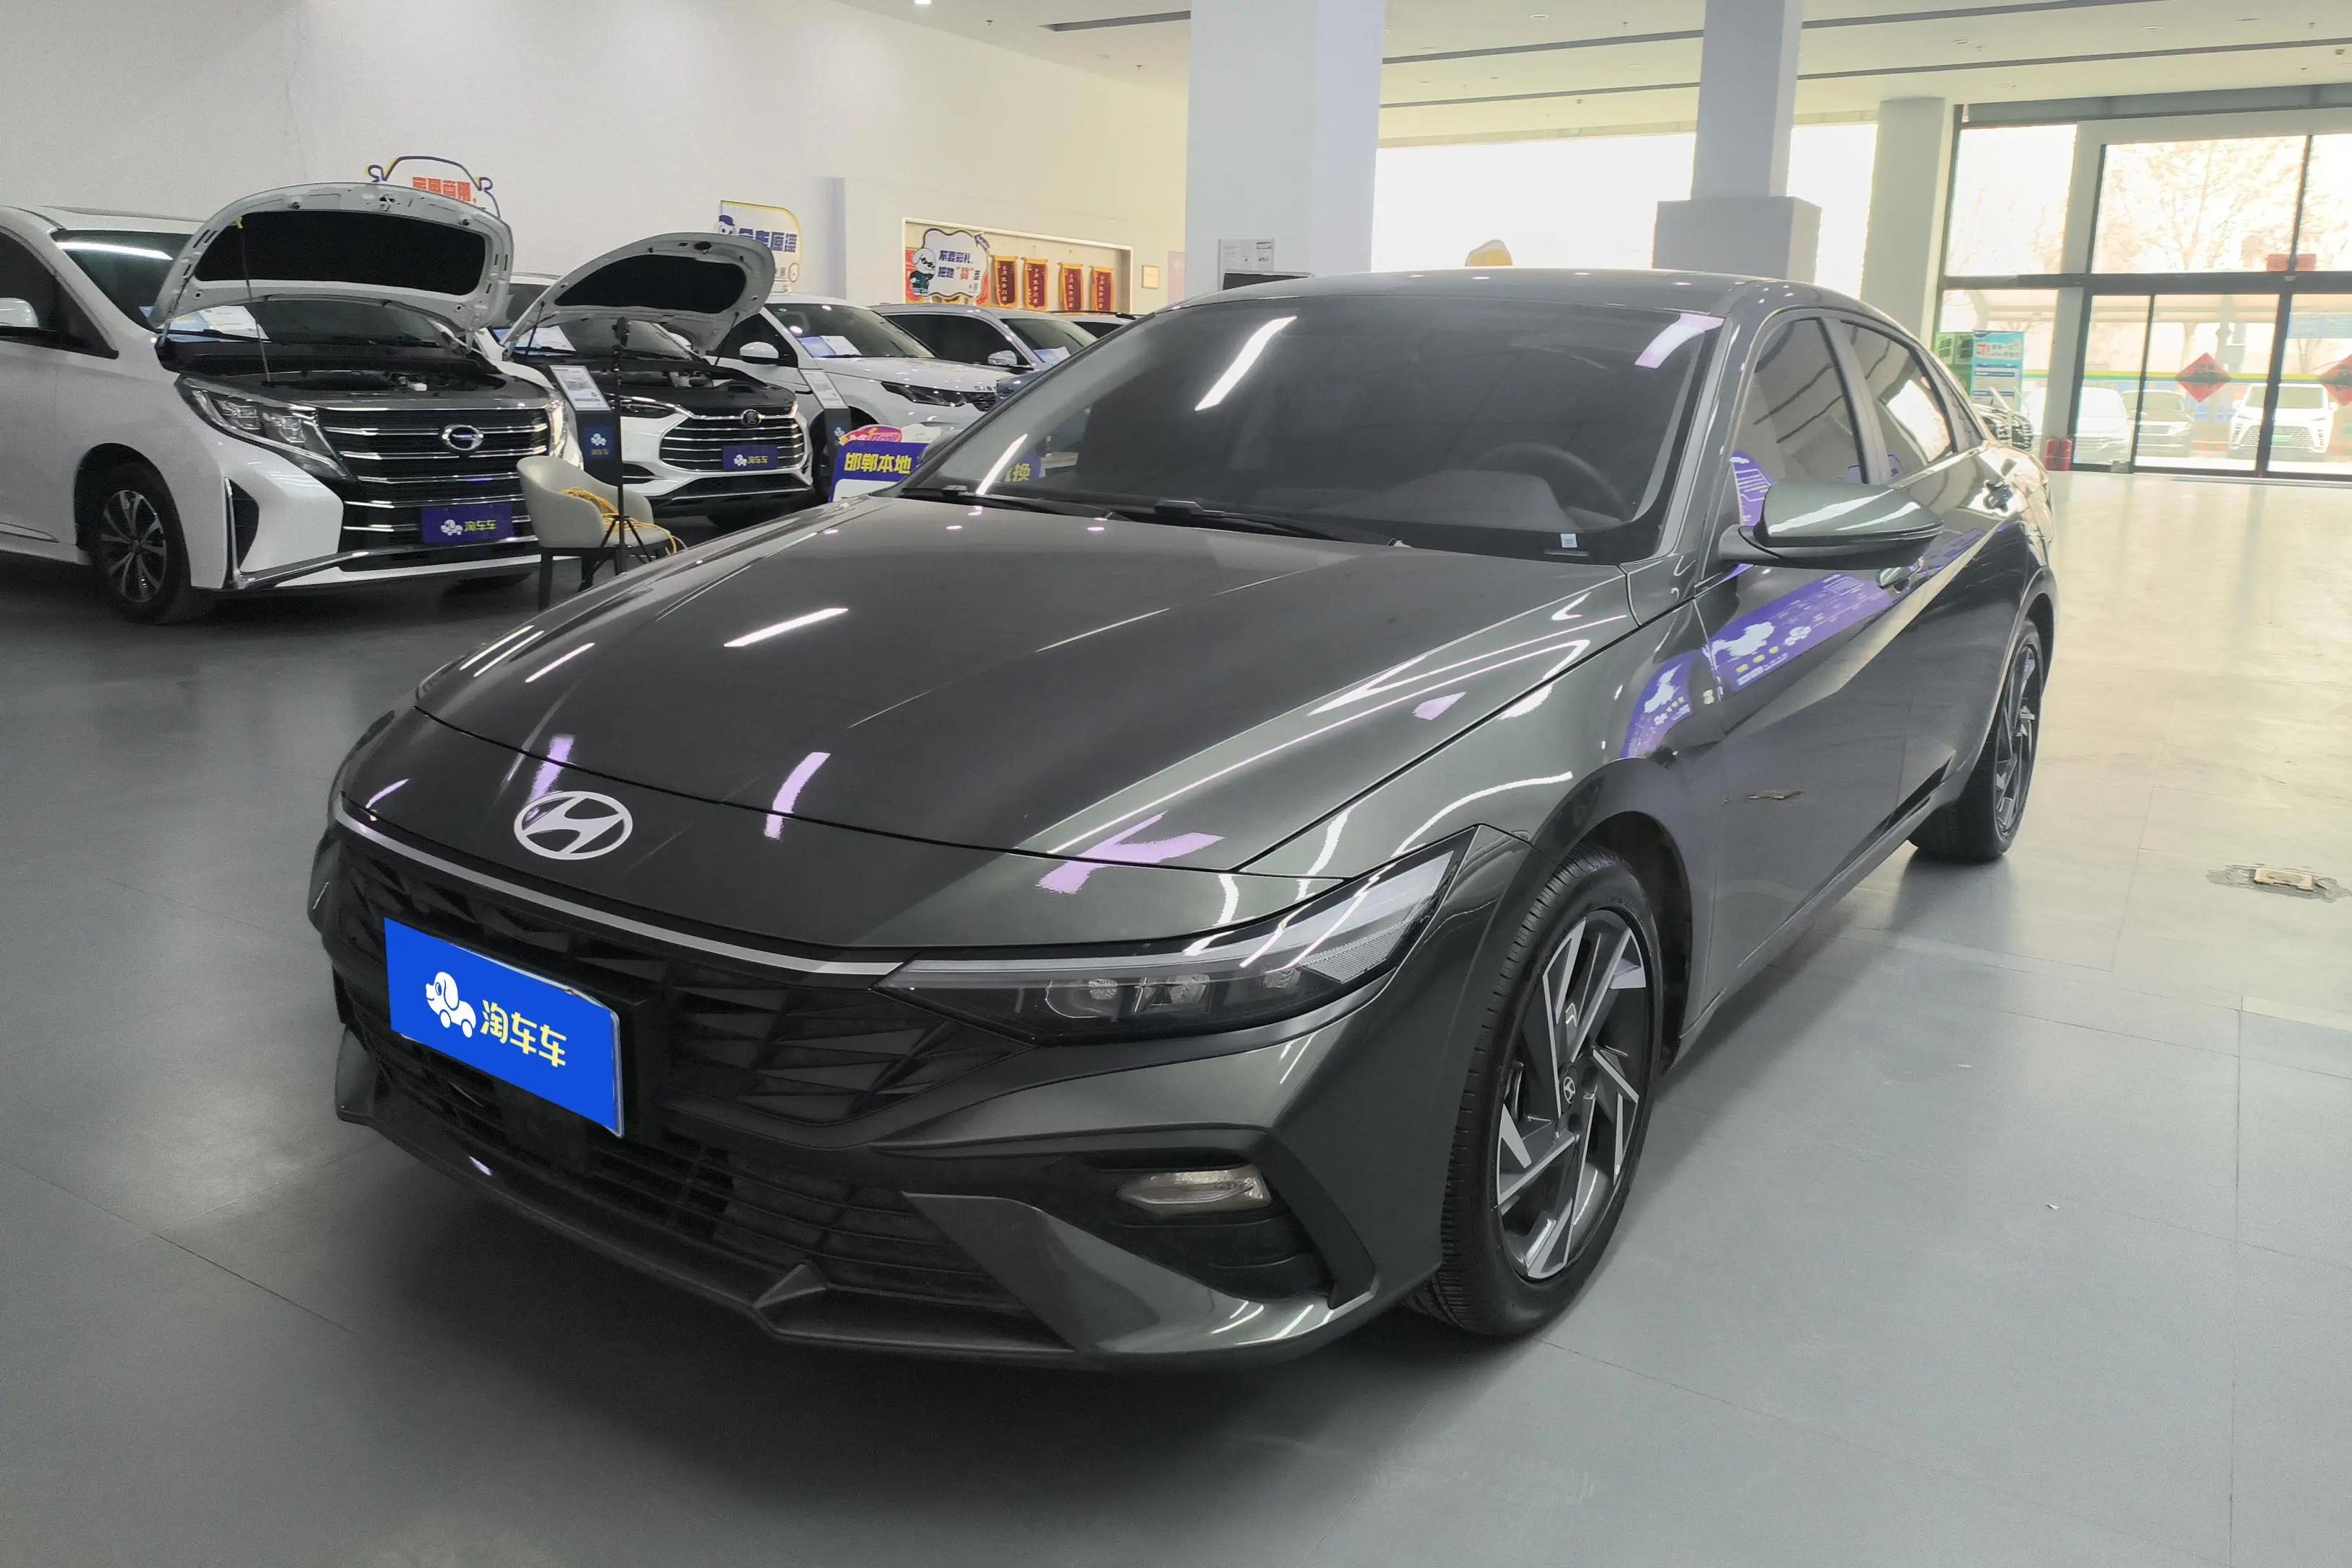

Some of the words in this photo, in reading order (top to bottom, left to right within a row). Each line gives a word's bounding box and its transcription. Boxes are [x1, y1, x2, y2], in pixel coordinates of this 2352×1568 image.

[844, 452, 919, 474] 邯郸本地
[464, 520, 496, 532] 淘车车
